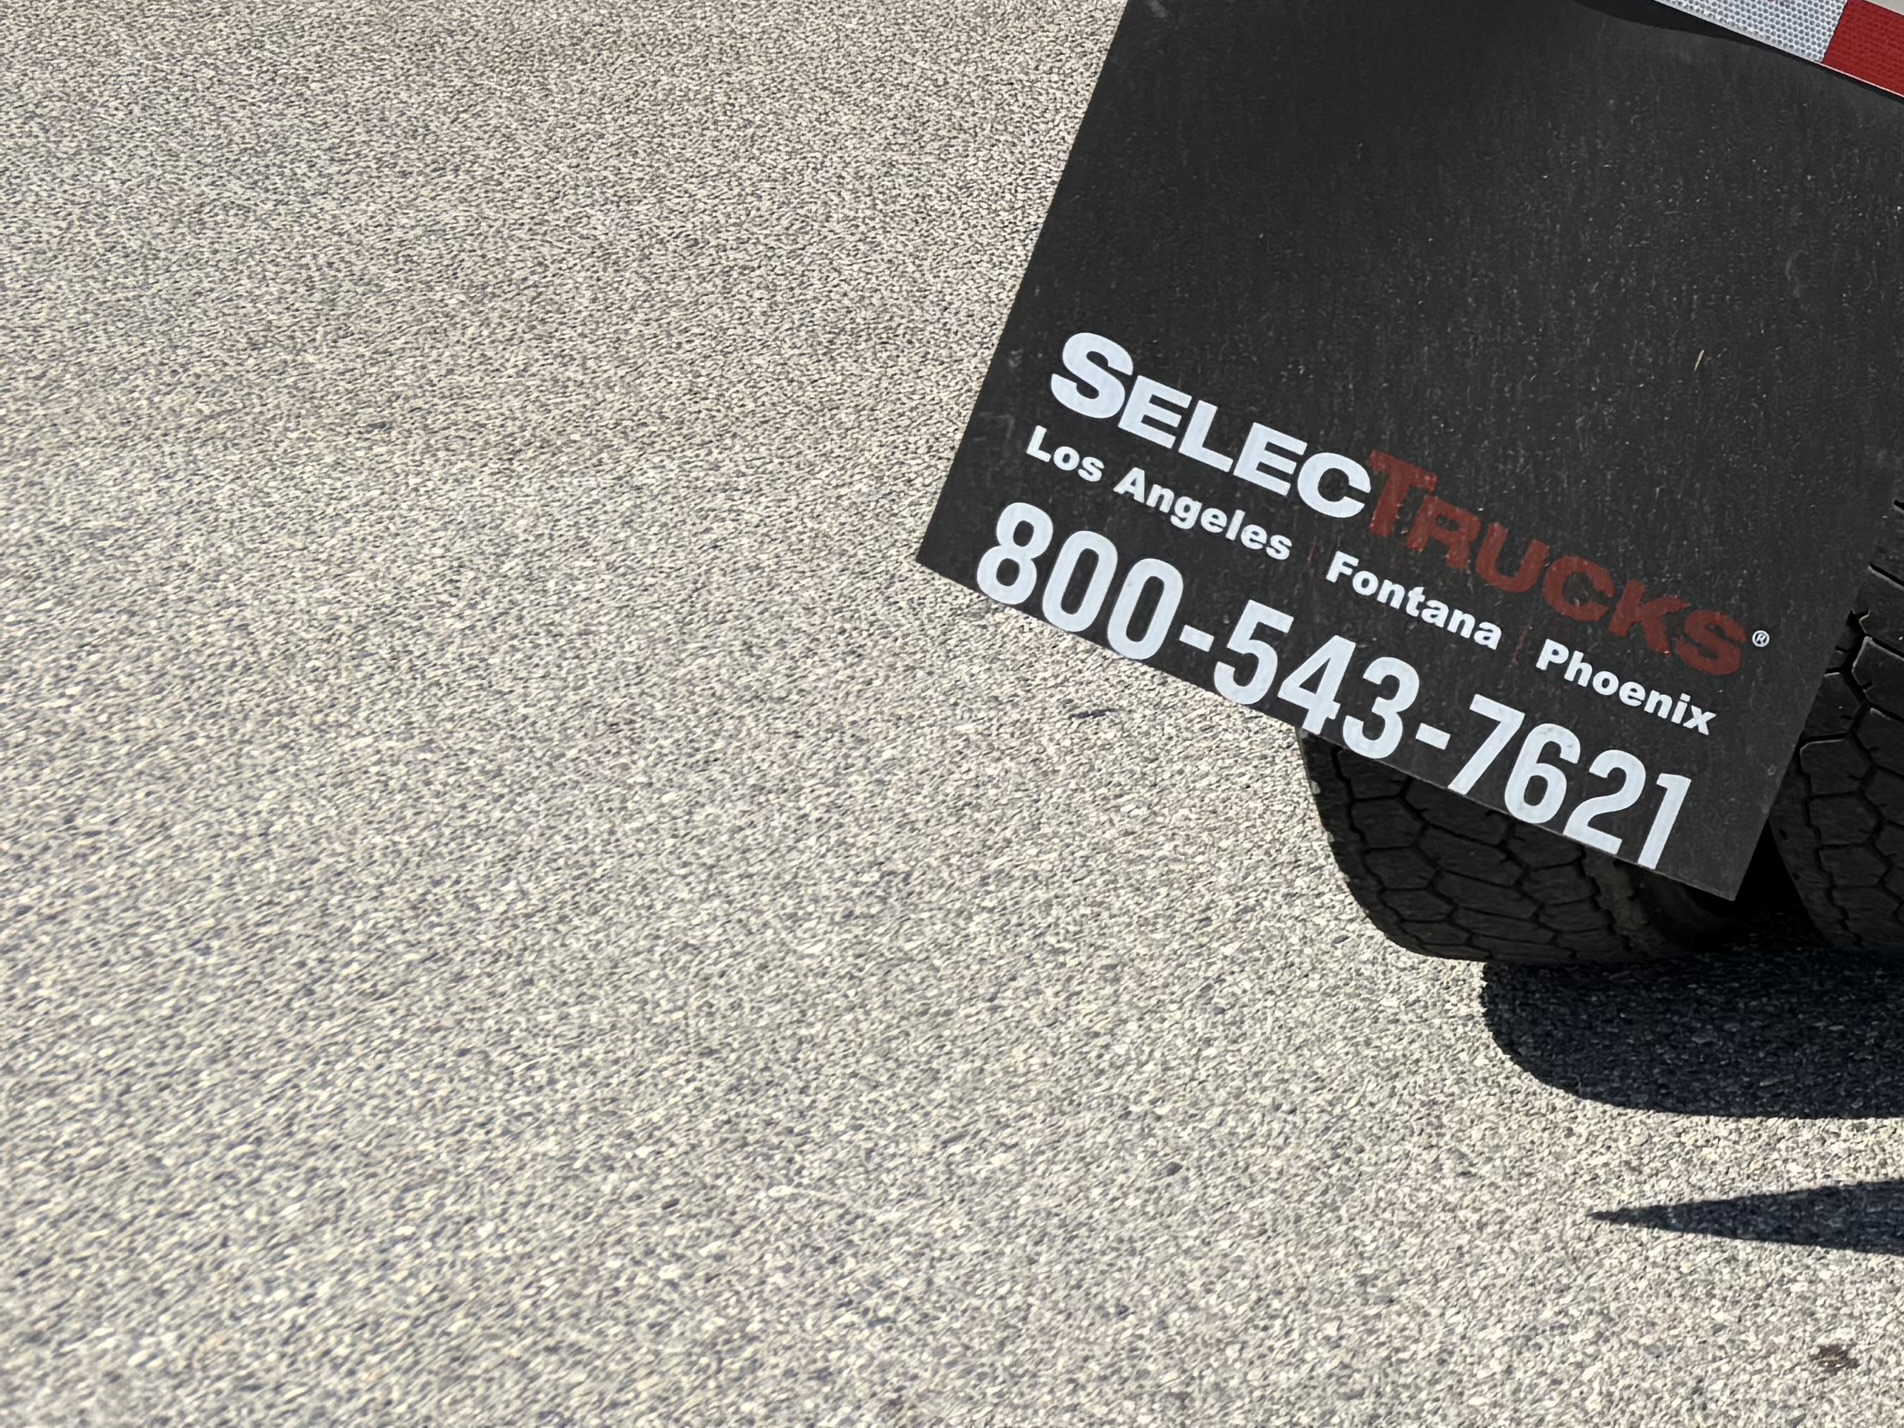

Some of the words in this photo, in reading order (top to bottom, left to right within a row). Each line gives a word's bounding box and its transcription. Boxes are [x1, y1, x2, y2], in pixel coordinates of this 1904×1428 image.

[976, 501, 1693, 870] 800-543-7621
[1026, 425, 1103, 484] Los
[1114, 467, 1293, 562] Angeles
[1325, 549, 1503, 650] Fontana
[1534, 637, 1717, 736] Phoenix
